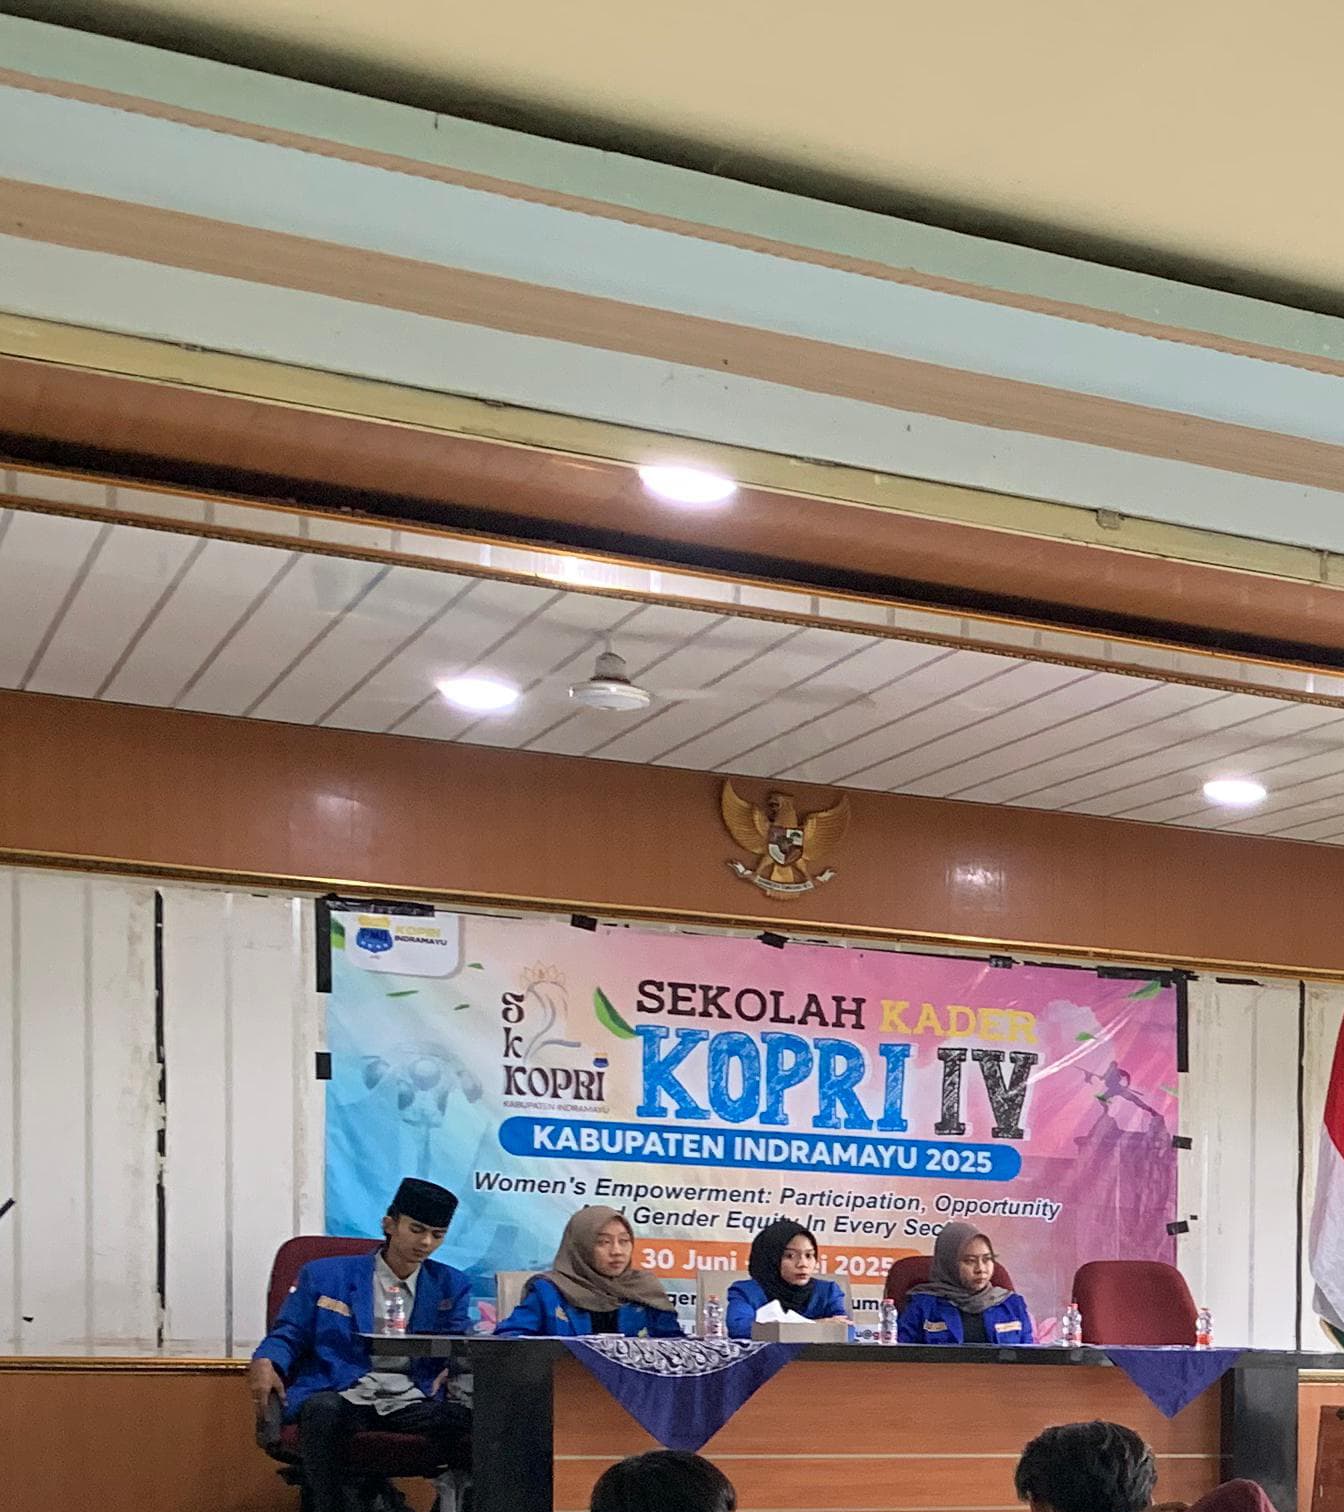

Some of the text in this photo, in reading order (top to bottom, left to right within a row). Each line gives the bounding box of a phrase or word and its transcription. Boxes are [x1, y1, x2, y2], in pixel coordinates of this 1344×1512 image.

[636, 979, 1039, 1045] SEKOLAH KADER
[636, 1024, 1039, 1140] KOPRI IV
[533, 1125, 993, 1174] KABUPATEN INDRAMAYU 2025
[475, 1171, 1060, 1221] Women's Empowerment: Participation, Opportunity
[633, 1206, 719, 1227] Gender
[726, 1211, 799, 1233] Equ
[806, 1214, 826, 1232] In
[834, 1215, 897, 1239] Every
[640, 1248, 675, 1270] 30
[682, 1249, 737, 1272] Juni
[834, 1256, 894, 1277] 2025
